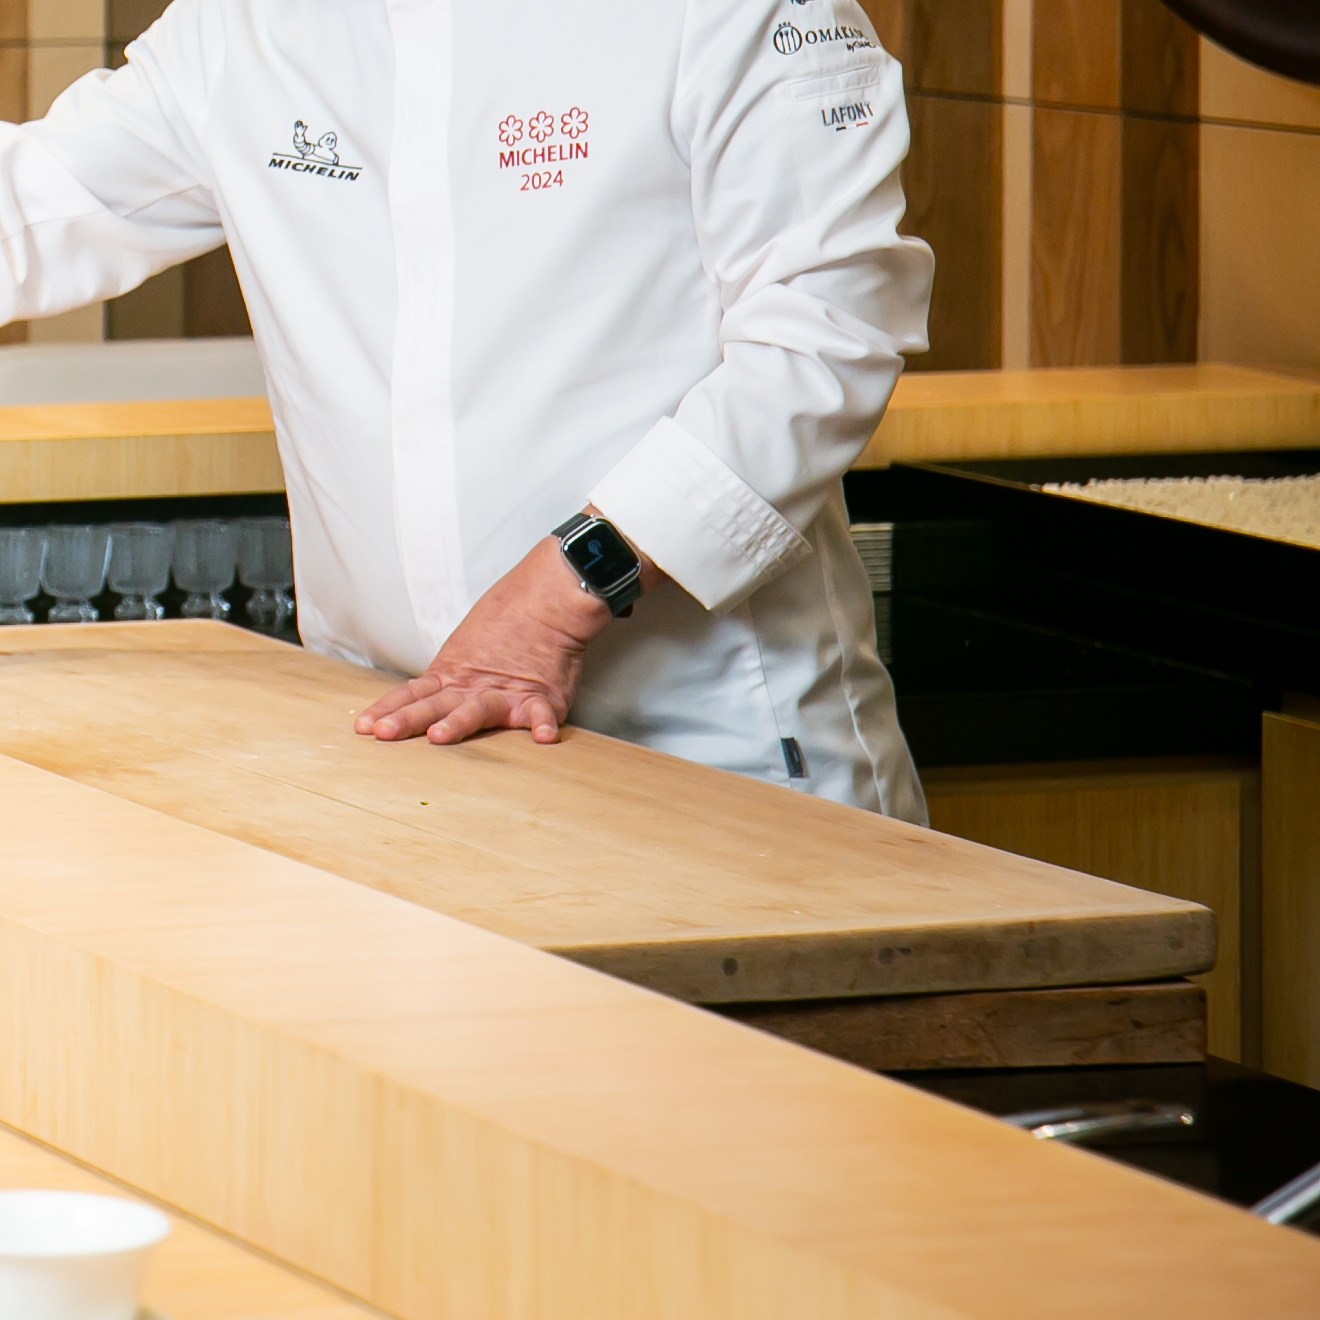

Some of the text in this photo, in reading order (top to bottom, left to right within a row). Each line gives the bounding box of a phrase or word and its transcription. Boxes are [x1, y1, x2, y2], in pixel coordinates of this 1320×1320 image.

[821, 102, 874, 126] LAFONT
[499, 142, 588, 169] MICHELIN
[268, 158, 360, 181] MICHELIN
[520, 170, 564, 192] 2024
